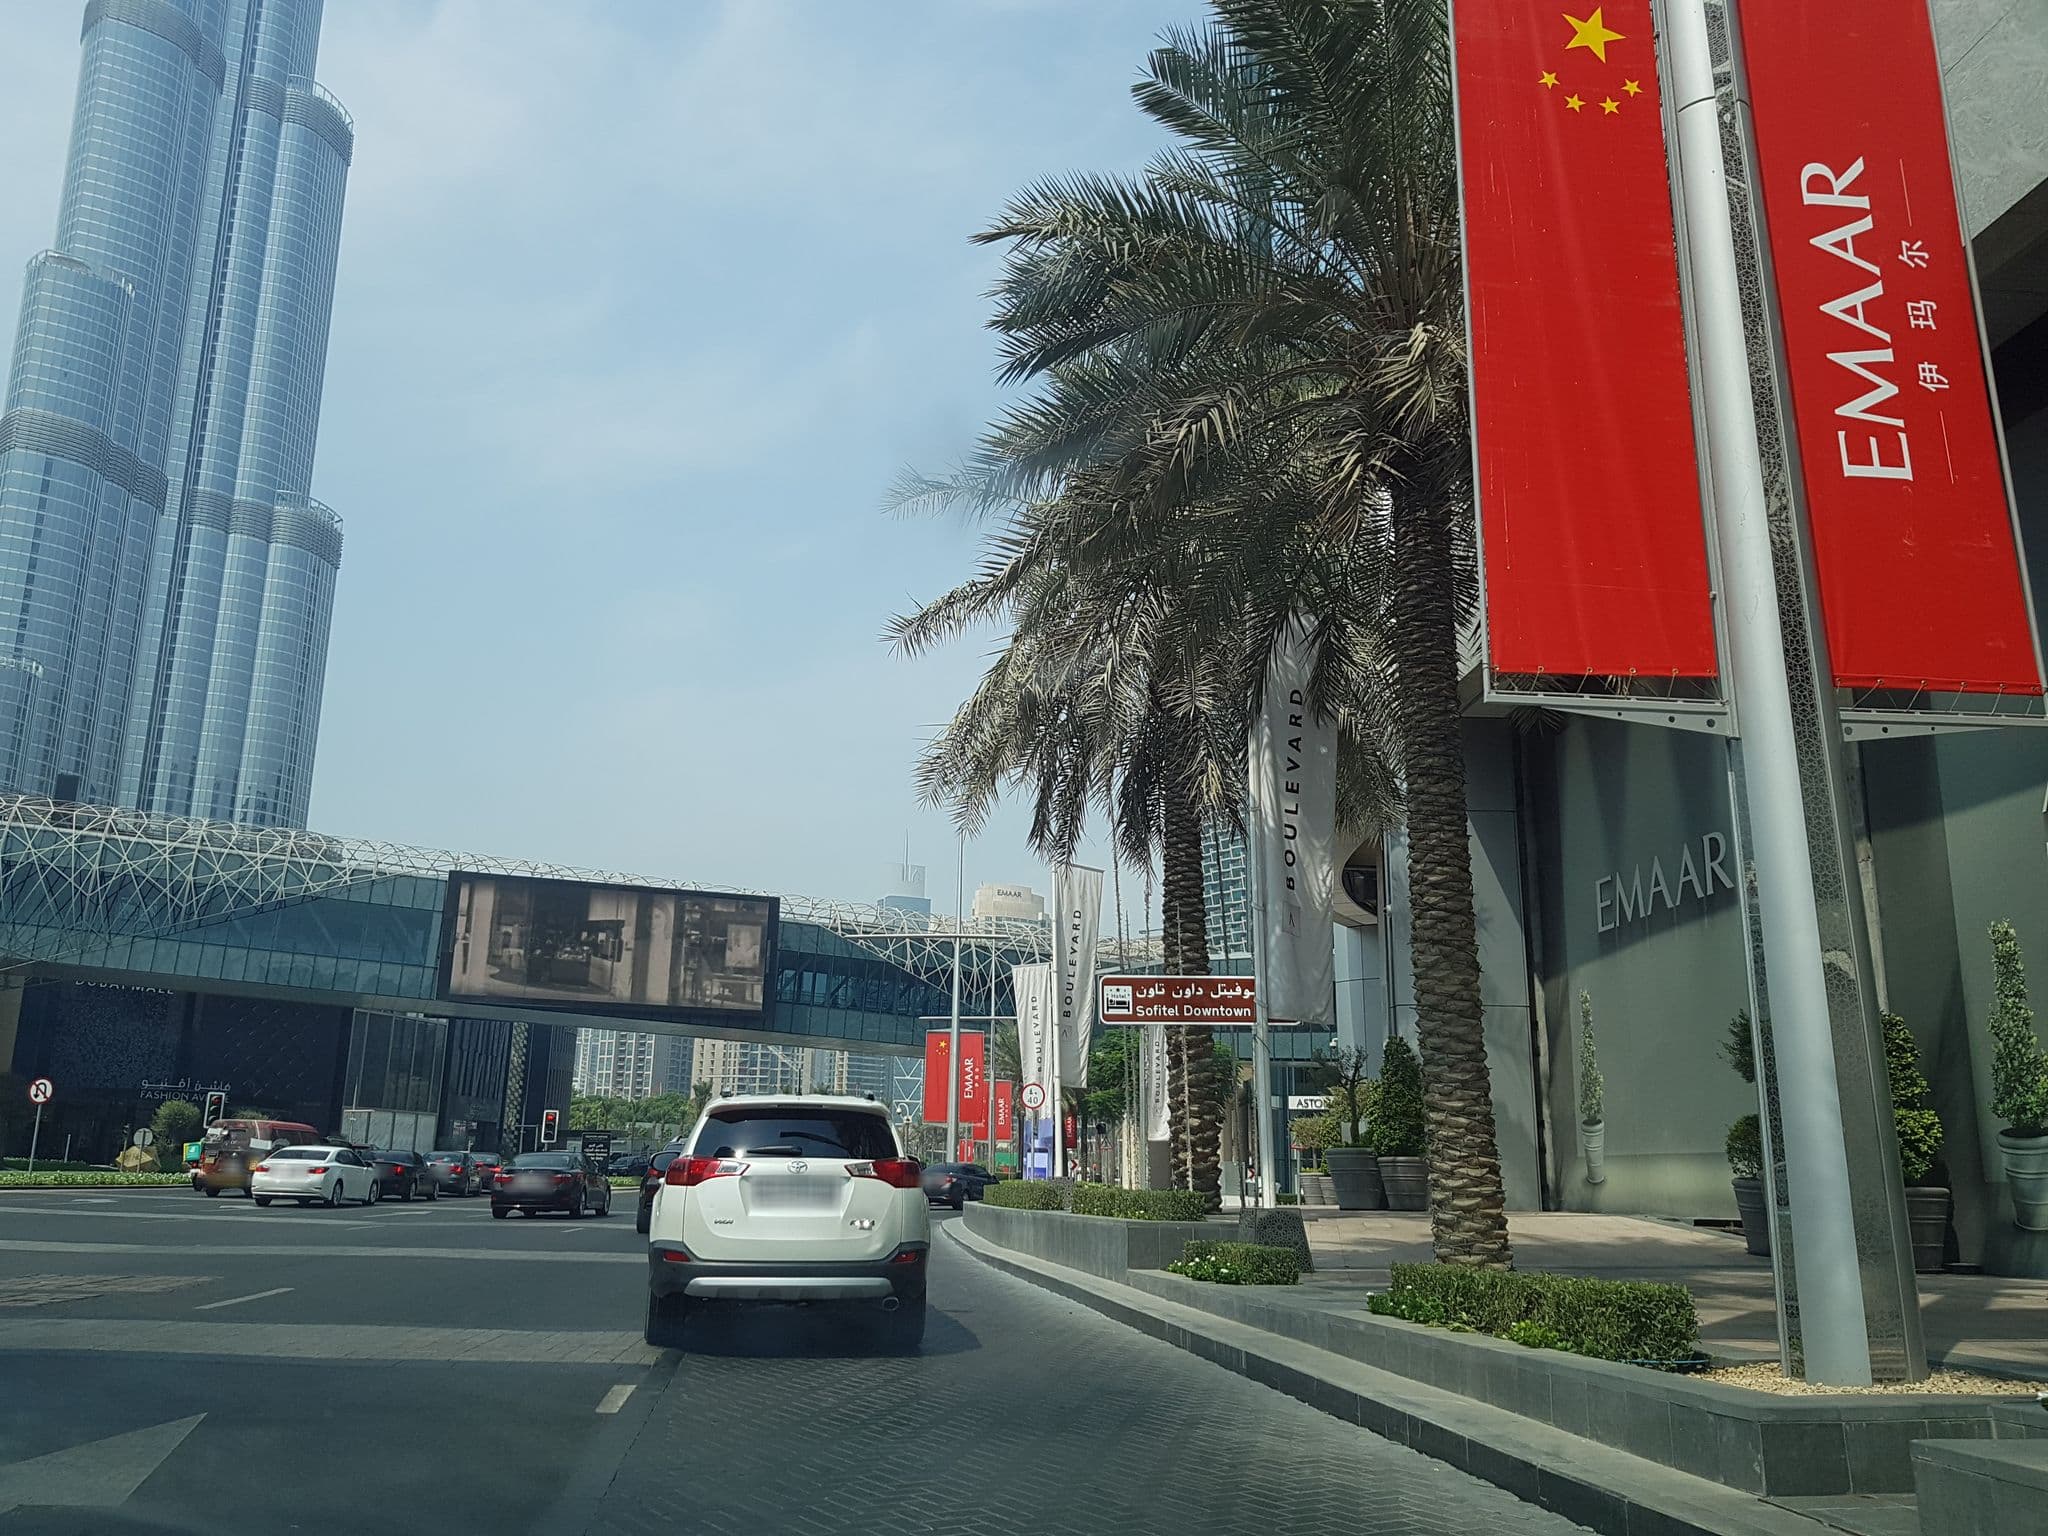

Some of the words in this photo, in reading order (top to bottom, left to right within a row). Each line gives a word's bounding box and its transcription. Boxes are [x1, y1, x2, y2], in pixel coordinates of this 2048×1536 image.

[1800, 156, 1914, 481] EMAAR
[1898, 239, 1949, 393] 伊玛尔
[1283, 688, 1303, 891] BOULEVARD
[997, 888, 1023, 898] EMAAR
[1595, 831, 1735, 933] EMAAR
[1062, 909, 1082, 1018] BOULEVARD
[1136, 982, 1165, 999] تاون
[1172, 982, 1204, 999] داون
[1210, 981, 1255, 999] وفيتل
[1136, 1005, 1179, 1017] Sofitel
[1184, 1005, 1251, 1017] Downtown
[963, 1057, 974, 1099] EMAAR
[140, 1089, 189, 1101] FASHION
[1026, 1096, 1039, 1104] 40
[997, 1096, 1005, 1126] EMAAR
